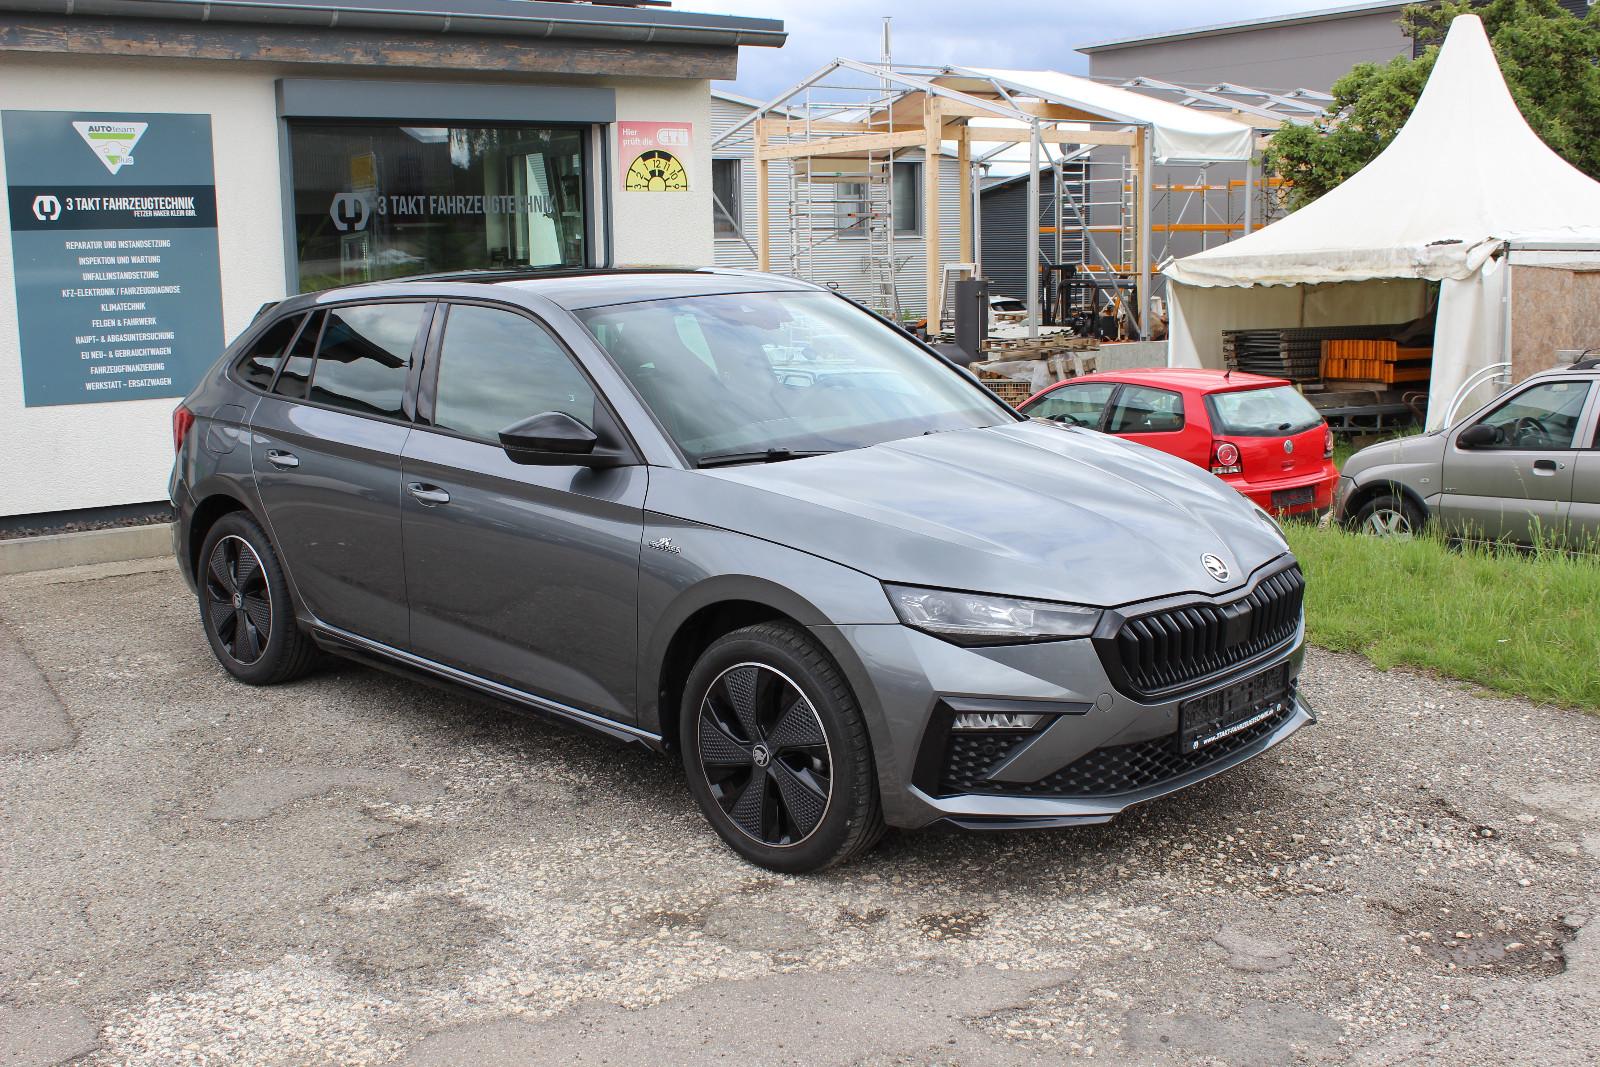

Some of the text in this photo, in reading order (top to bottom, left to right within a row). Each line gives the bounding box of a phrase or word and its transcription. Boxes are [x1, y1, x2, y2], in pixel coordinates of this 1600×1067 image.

[88, 125, 136, 133] AUTOteam
[622, 128, 637, 136] Hier
[642, 136, 653, 146] die
[652, 160, 661, 168] 12
[663, 162, 671, 171] 11
[66, 197, 195, 211] 3 TAKT FAHRZEUGTECHNIK
[377, 195, 387, 215] 3
[390, 195, 426, 215] TAKT
[65, 239, 171, 250] REPARATUR UND INSTANDSETZUNG
[78, 255, 161, 266] INSPEKTION UND WARTUNG
[82, 270, 160, 281] UNFALLINSTANDSETZUNG
[62, 287, 116, 298] KFZ-ELEKTRONIK
[120, 285, 181, 296] FAHRZEUGDIAGNOSE
[101, 302, 146, 312] KLIMATECHNIK
[92, 318, 116, 328] FELGEN
[123, 317, 157, 327] FAHRWERK
[75, 335, 100, 345] HAUPT-
[107, 331, 175, 343] ABGASUNTERSUCHUNG
[81, 351, 90, 360] EU
[114, 347, 172, 358] GEBRAUCHTWAGEN
[90, 362, 165, 375] FAHRZEUGFINANZIERUNG
[85, 380, 122, 391] WERKSTATT
[128, 377, 172, 388] ERSATZWAGEN
